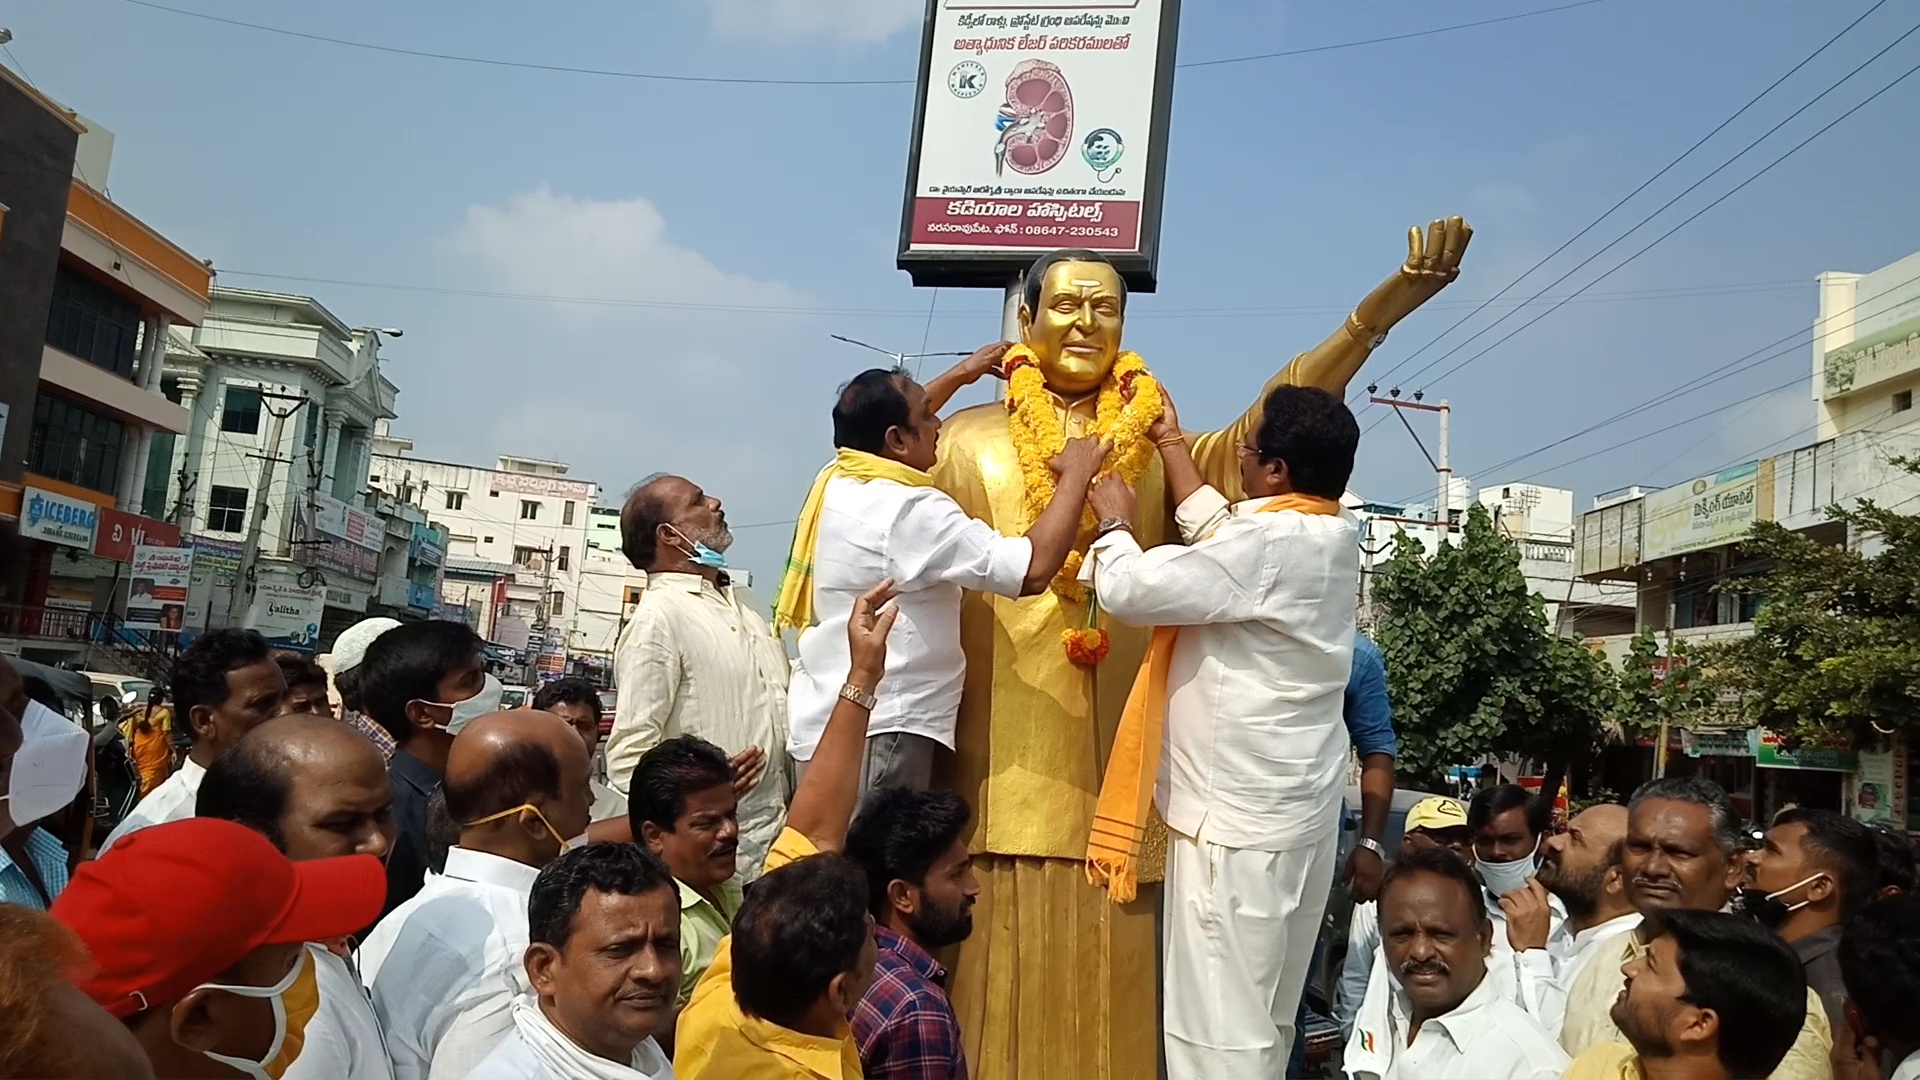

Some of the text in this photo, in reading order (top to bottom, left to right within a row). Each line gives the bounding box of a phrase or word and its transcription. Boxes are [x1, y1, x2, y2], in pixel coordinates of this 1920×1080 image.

[953, 33, 1131, 56] అత్యాధునిక లేజర్ పరికరములతో
[946, 199, 1103, 222] కడియాల హాస్పిటల్స్
[1025, 225, 1119, 237] 08647-230543
[43, 500, 97, 529] ICEBERG
